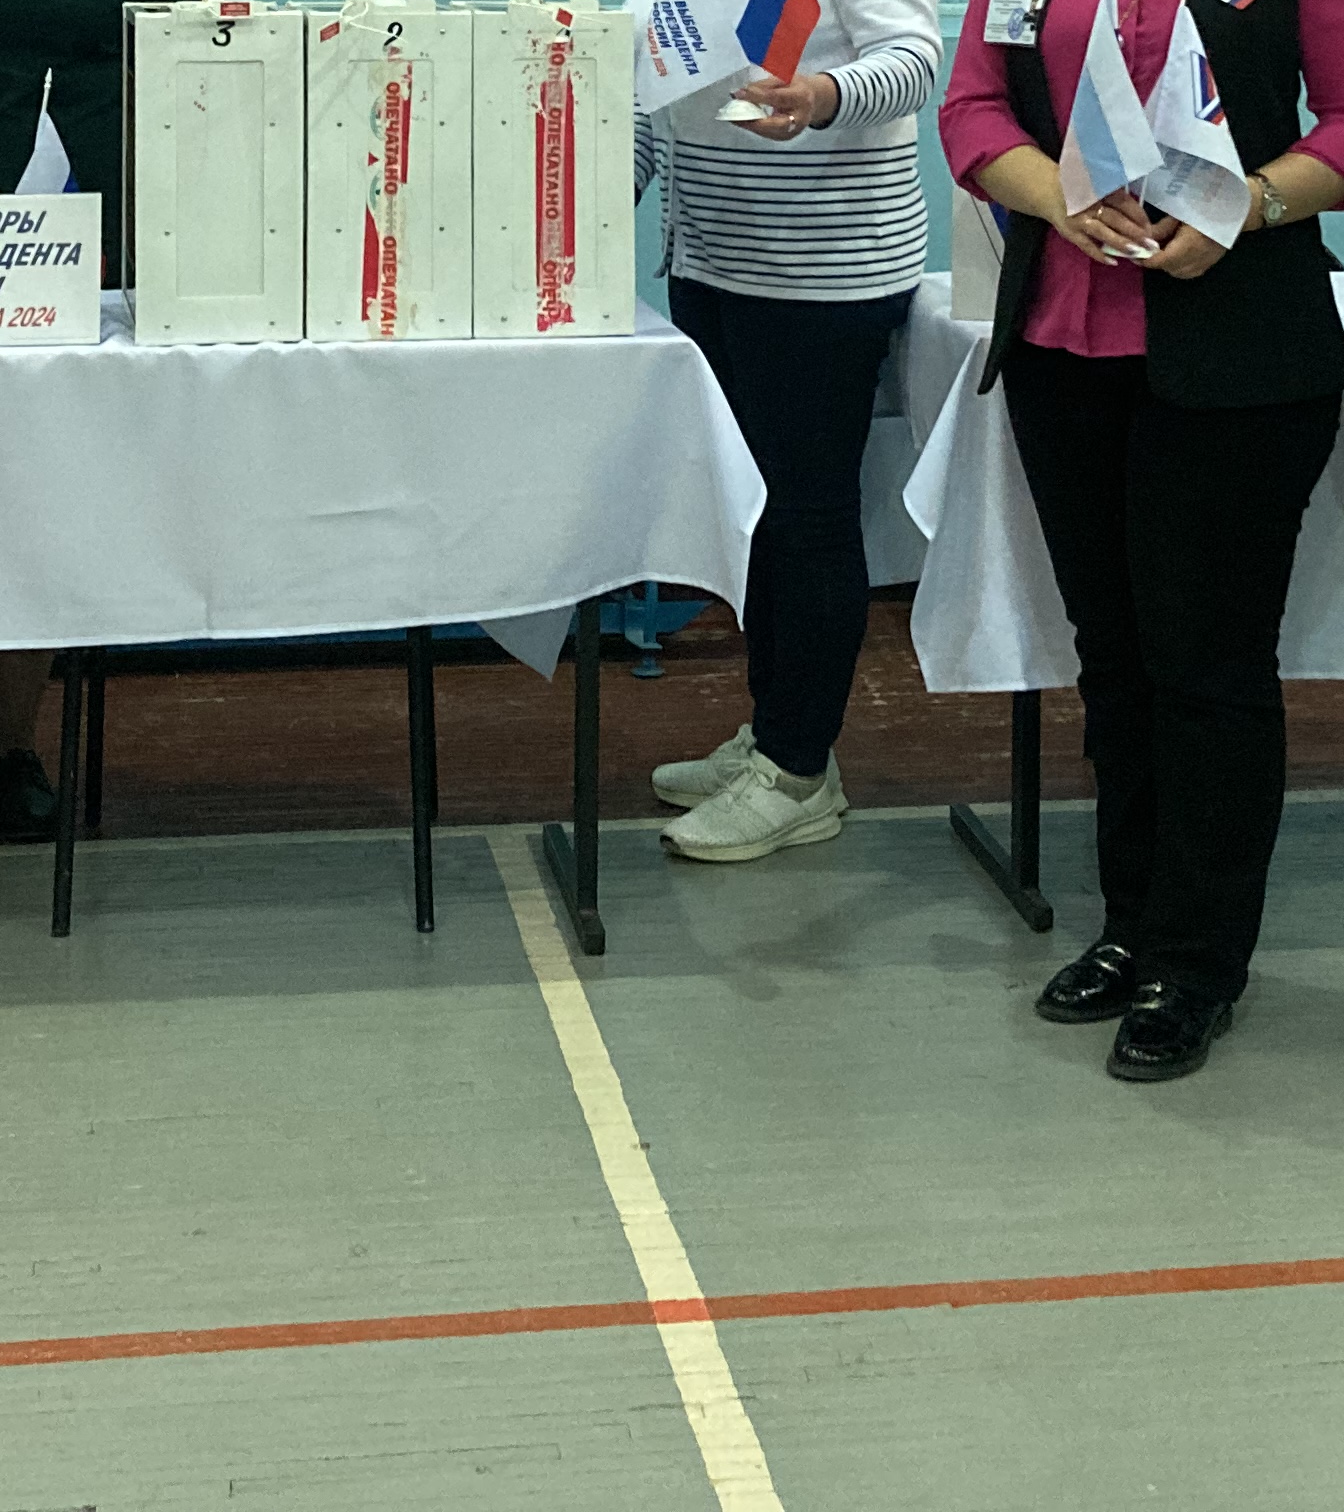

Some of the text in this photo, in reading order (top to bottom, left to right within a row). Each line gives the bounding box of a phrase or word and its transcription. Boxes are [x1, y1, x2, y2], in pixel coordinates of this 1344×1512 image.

[212, 20, 236, 47] 3
[383, 21, 403, 50] 2
[660, 1, 701, 76] ПРЕЗИДЕНТА
[674, 0, 708, 52] ВЫБОРЫ
[384, 81, 401, 197] ОПЕЧАТАНО
[545, 107, 563, 220] ОПЕЧАТАНО
[7, 306, 57, 328] 2024
[381, 235, 398, 336] ОПЕЧАТАН
